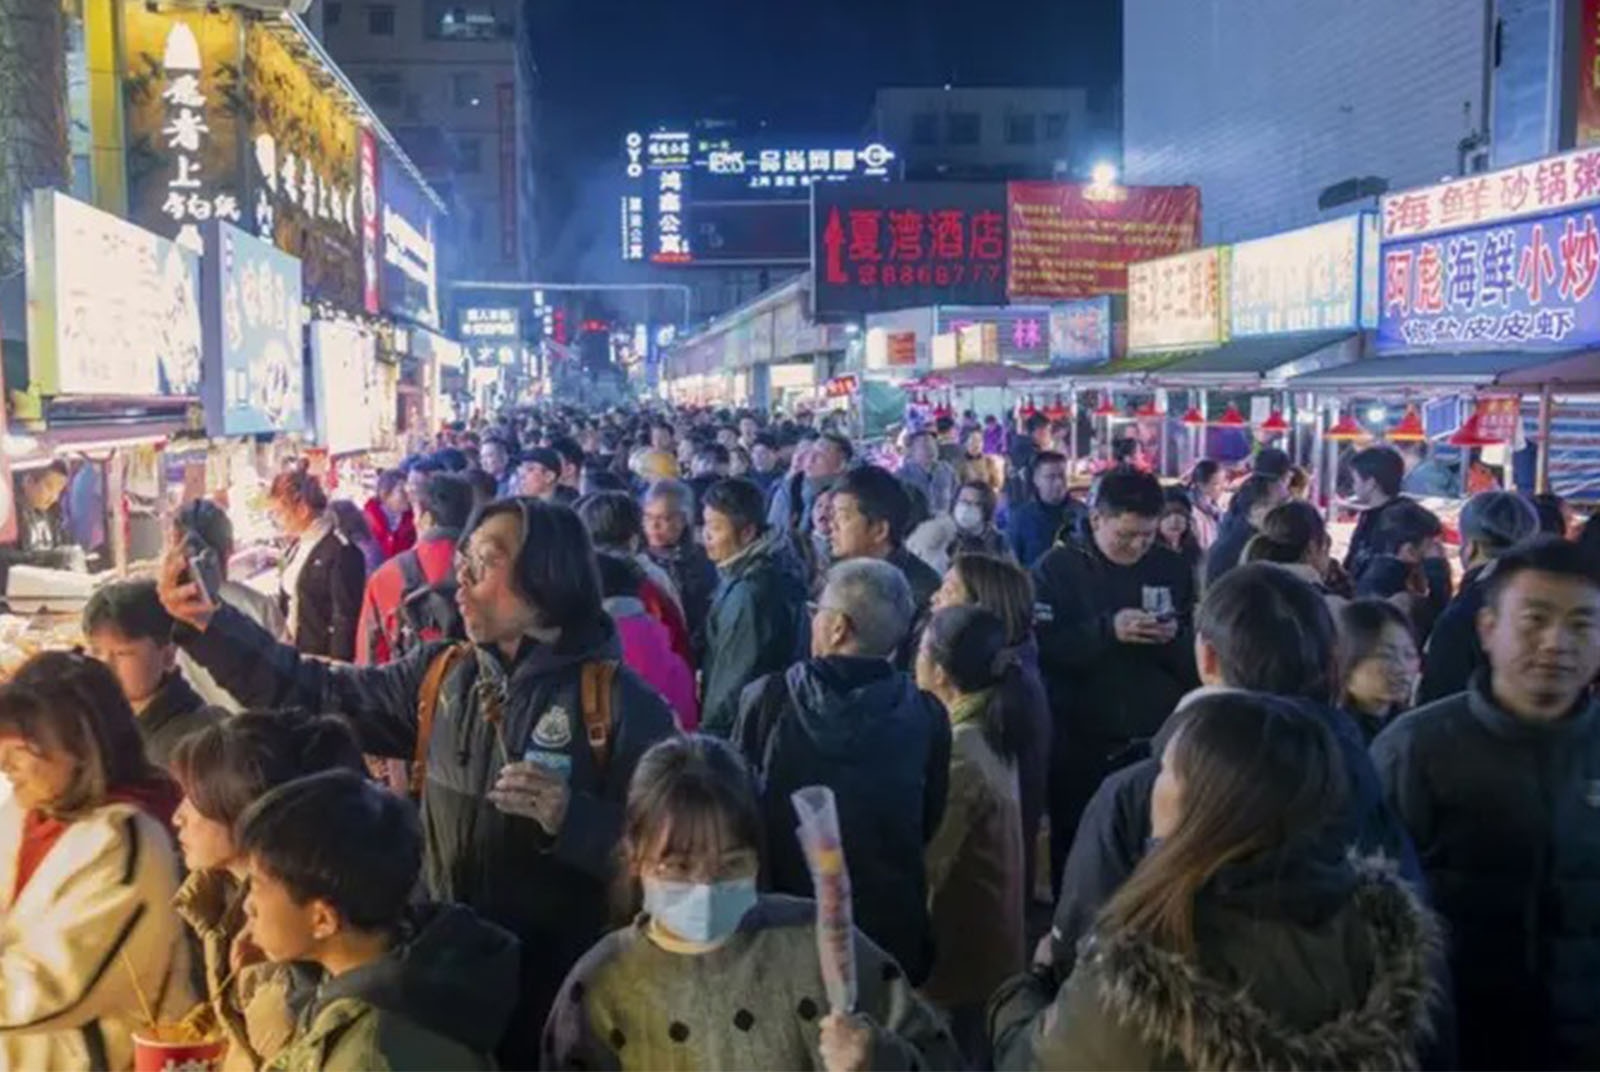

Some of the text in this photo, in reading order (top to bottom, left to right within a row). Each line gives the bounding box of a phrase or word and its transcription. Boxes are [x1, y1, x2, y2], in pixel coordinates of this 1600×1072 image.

[848, 208, 1003, 261] 夏湾酒店
[1386, 152, 1600, 235] 海鲜砂锅粥
[1385, 214, 1599, 318] 阿彪海鲜小炒
